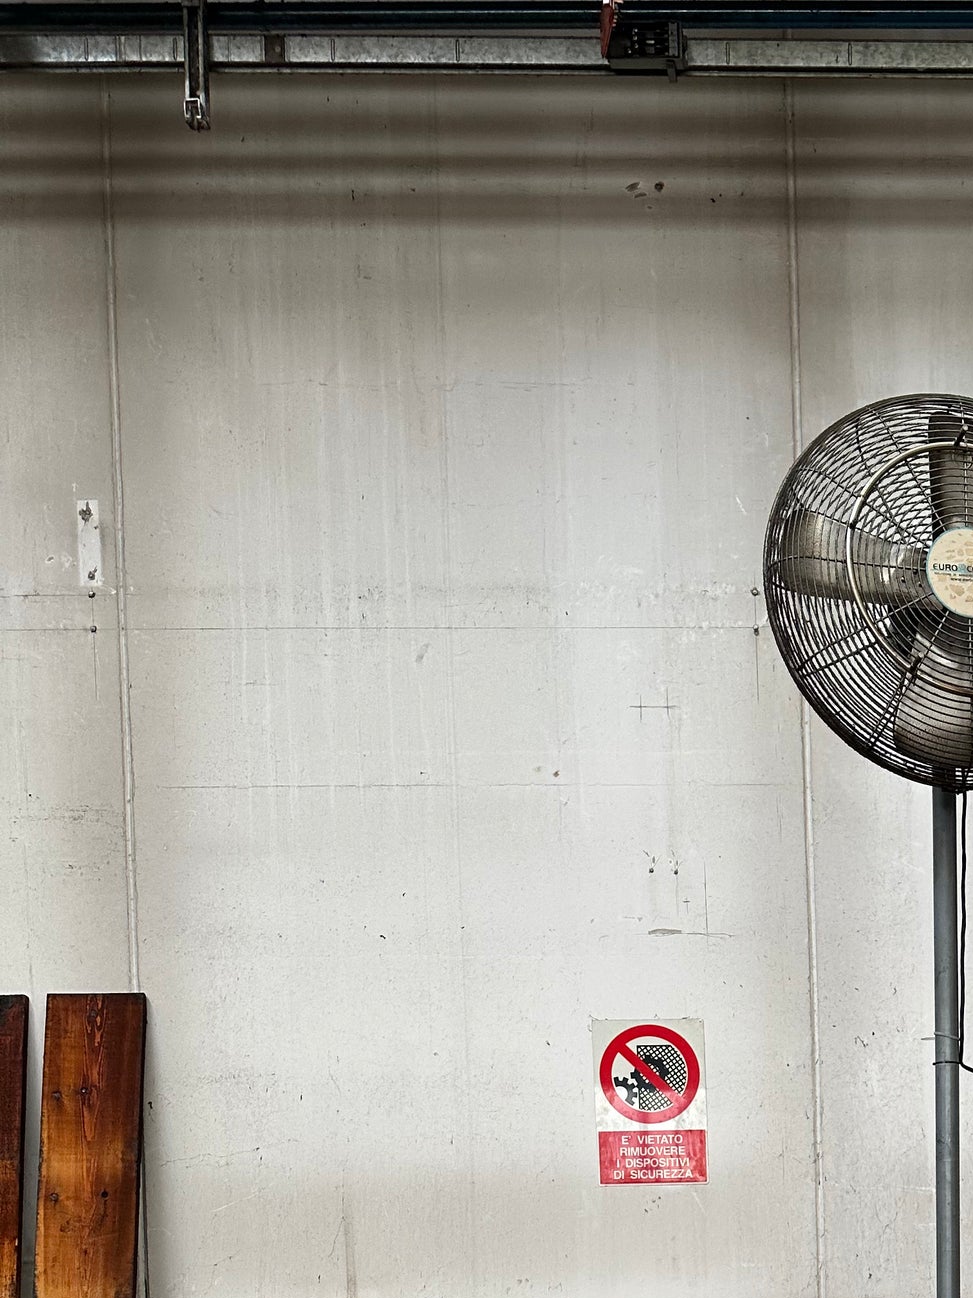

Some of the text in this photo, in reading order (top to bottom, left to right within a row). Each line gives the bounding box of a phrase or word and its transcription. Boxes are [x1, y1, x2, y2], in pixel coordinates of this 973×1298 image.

[933, 563, 958, 571] EURO
[637, 1134, 683, 1144] VIETATO
[620, 1146, 685, 1156] RIMUOVERE
[616, 1158, 690, 1168] I DISPOSITIVI
[613, 1169, 693, 1180] DI SICUREZZA
